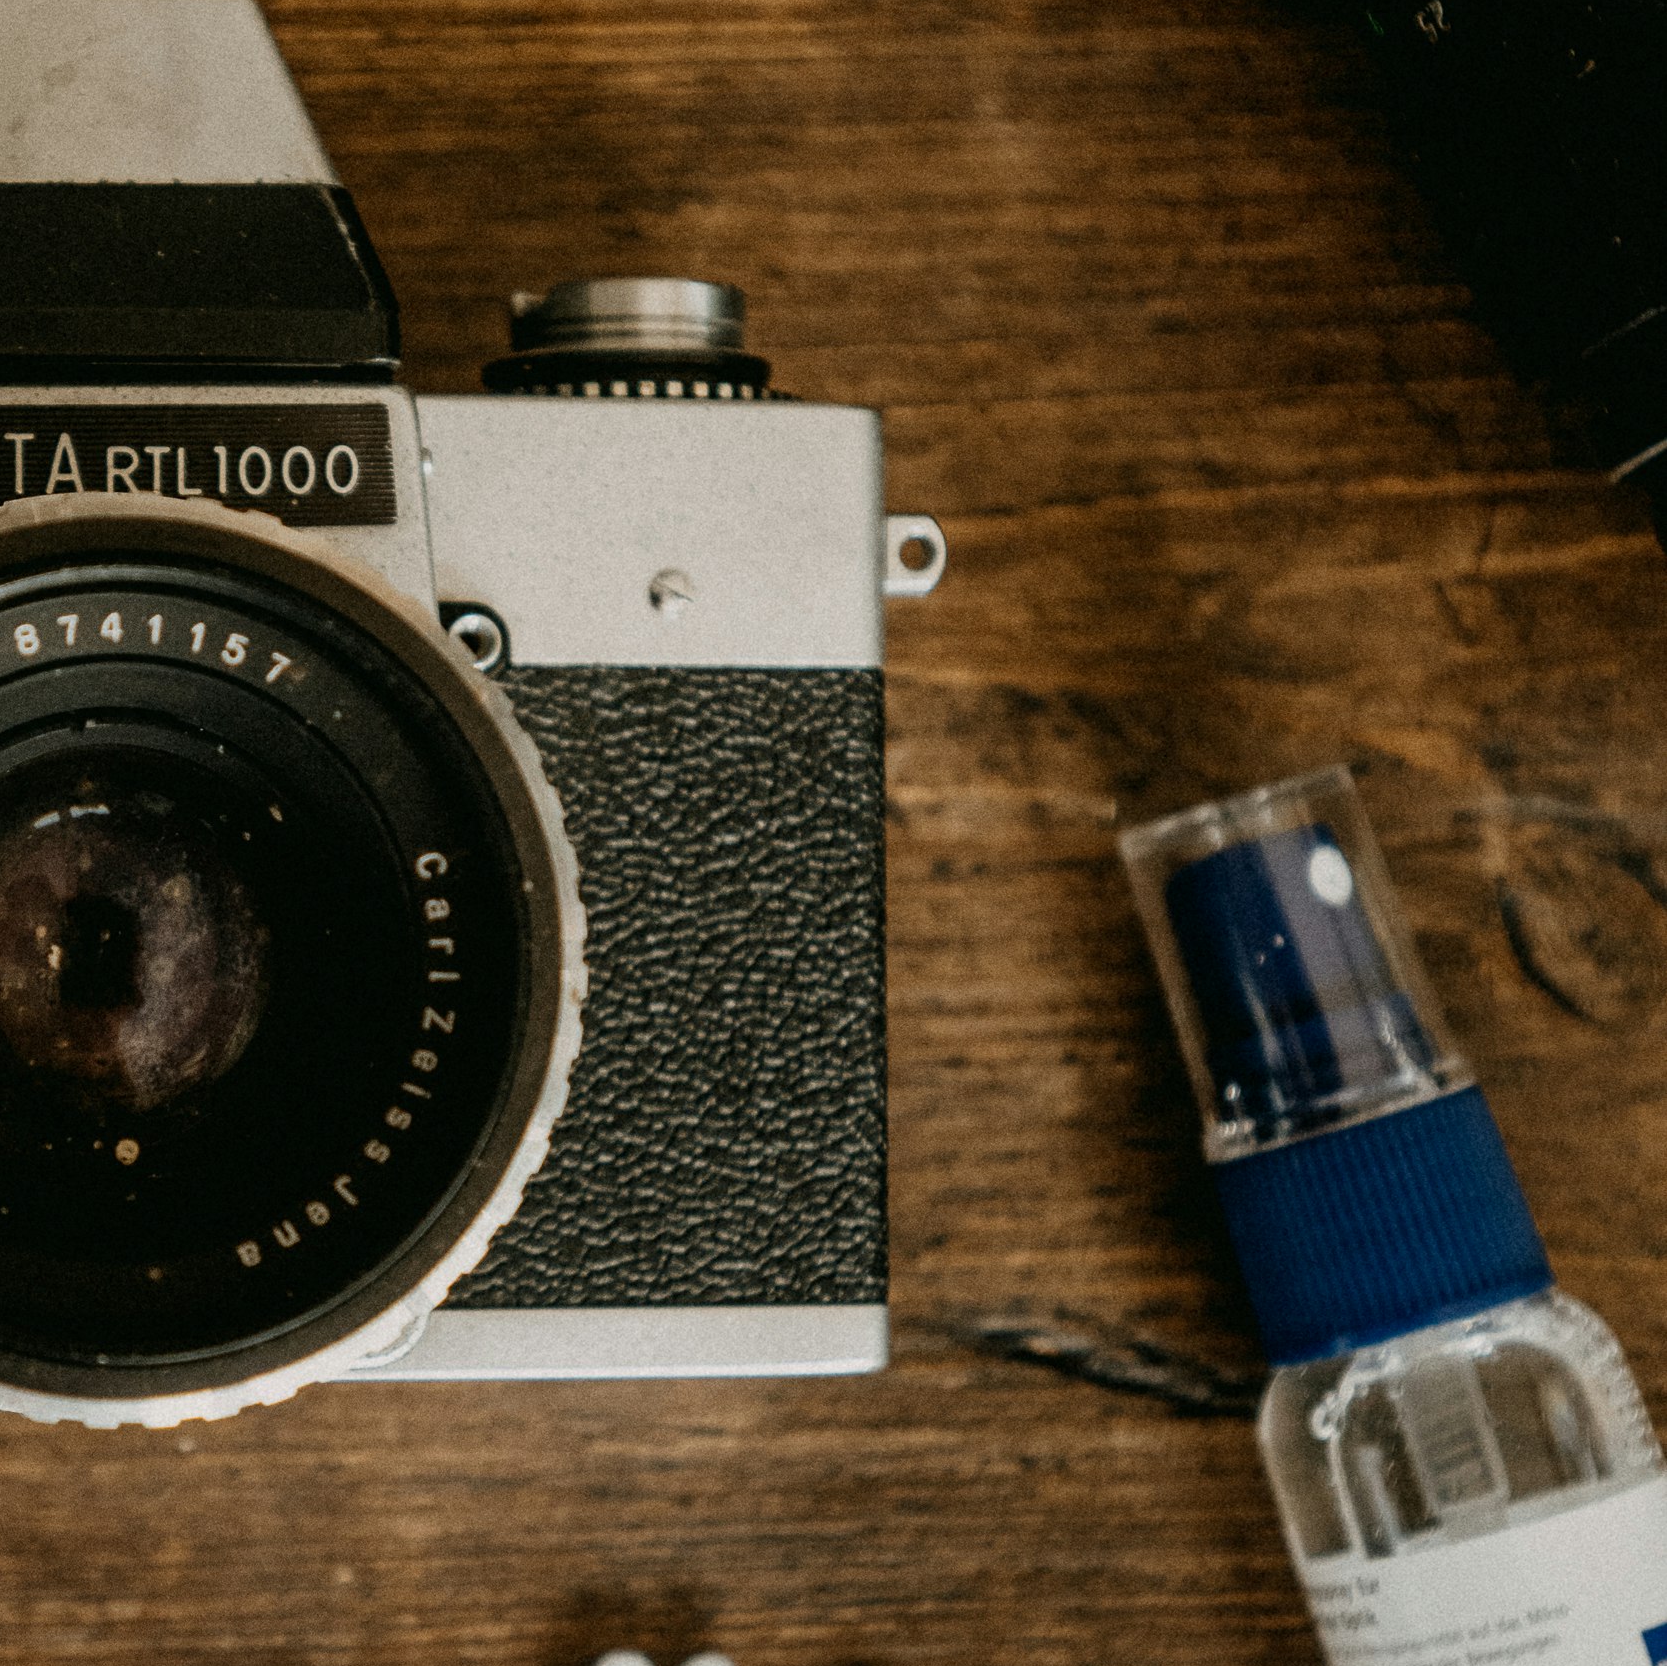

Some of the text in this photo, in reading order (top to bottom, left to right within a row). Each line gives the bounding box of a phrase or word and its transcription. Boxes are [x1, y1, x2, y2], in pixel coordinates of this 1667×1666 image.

[14, 611, 292, 684] 8741157
[235, 849, 461, 1270] Carl Zeiss Jena
